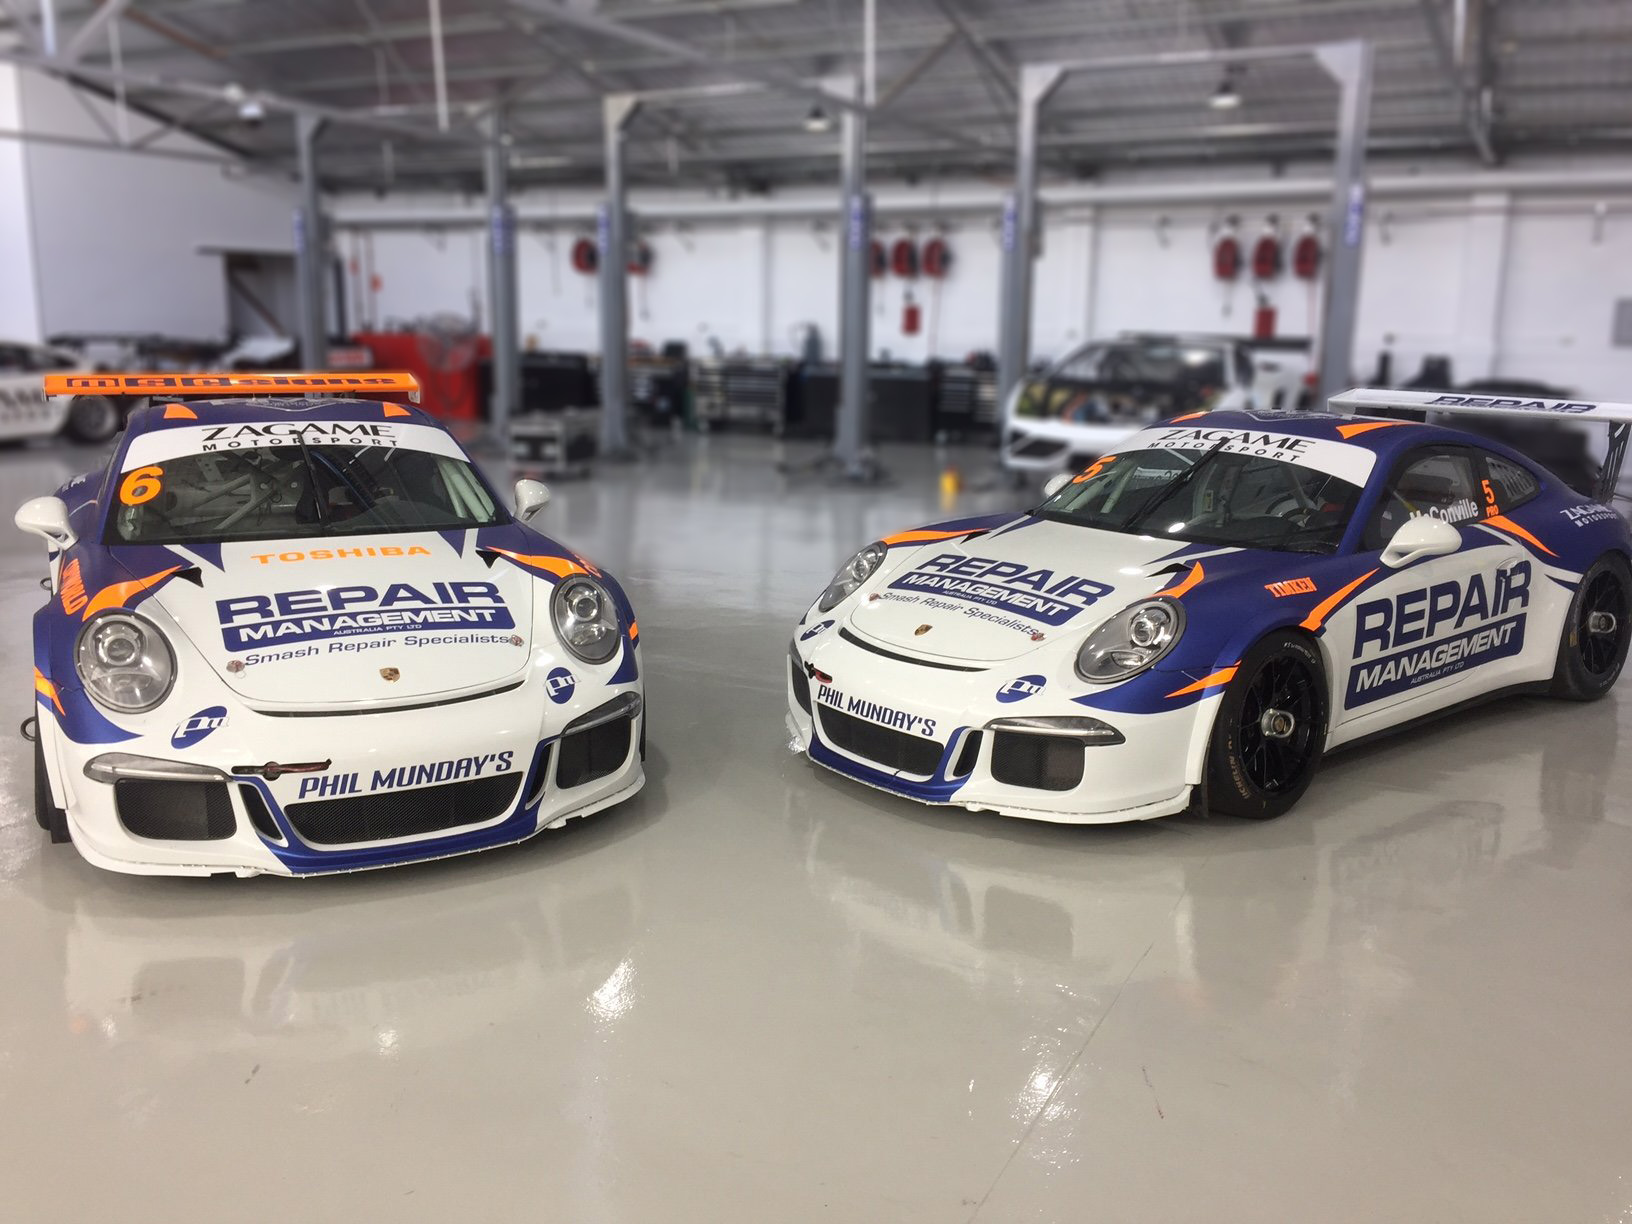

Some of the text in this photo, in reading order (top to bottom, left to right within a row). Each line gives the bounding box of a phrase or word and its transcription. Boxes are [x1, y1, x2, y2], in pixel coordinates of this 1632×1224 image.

[1425, 395, 1597, 414] REPAIR
[201, 423, 397, 441] ZAGAME
[202, 437, 400, 453] MOTORSPORT
[1158, 429, 1316, 454] ZAGAME
[1072, 455, 1117, 485] 5
[119, 466, 165, 505] 6
[1481, 479, 1496, 504] 5
[1486, 505, 1500, 518] PRO
[250, 546, 432, 565] TOSHIBA
[915, 553, 1116, 606] REPAIR
[1263, 577, 1318, 598] TIMKEN
[215, 581, 506, 625] REPAIR
[902, 574, 1071, 616] MANAGEMENT
[943, 589, 974, 601] AUSTRALIA
[1352, 560, 1532, 660] REPAIR
[239, 609, 496, 642] MANAGEMENT
[878, 592, 1040, 636] Smash Repair Specialists
[333, 626, 384, 636] AUSTRALIA
[244, 633, 510, 666] Smash Repair Specialists
[1355, 621, 1517, 693] MANAGEMENT
[1411, 661, 1465, 685] AUSTRALIA PTY LTD
[817, 684, 937, 737] PHIL MUNDAY'S
[298, 750, 514, 799] PHIL MUNDAY'S
